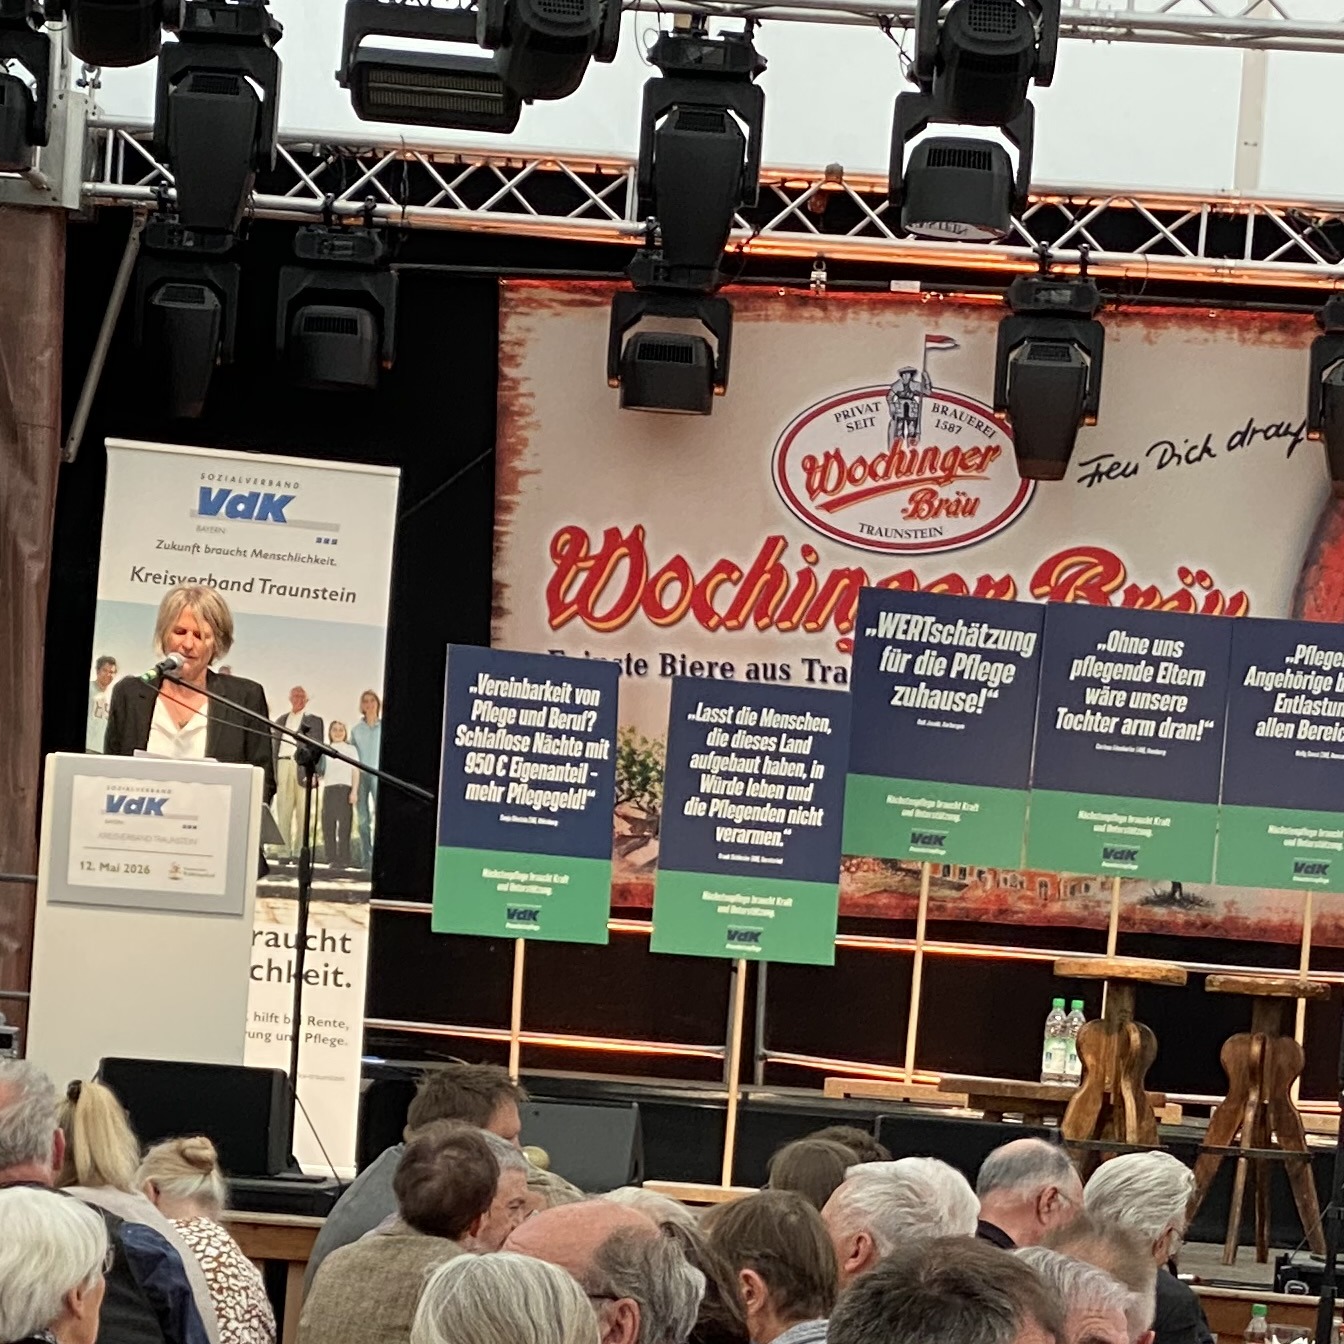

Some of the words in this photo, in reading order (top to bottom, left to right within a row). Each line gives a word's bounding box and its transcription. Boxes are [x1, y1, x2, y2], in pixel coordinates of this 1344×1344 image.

[834, 401, 882, 423] PRIVAT
[931, 402, 997, 440] BRAUEREI
[846, 417, 876, 433] SEIT
[934, 418, 962, 435] 1587
[801, 437, 1002, 502] Wochinger
[1077, 454, 1138, 488] Freu
[1146, 433, 1216, 470] Dich
[200, 472, 300, 489] SOZIALVERBAND
[198, 486, 296, 524] VdK
[901, 488, 981, 521] Bräu
[196, 525, 226, 534] BAYERN
[858, 522, 944, 540] TRAUNSTEIN
[156, 540, 200, 554] Zukunft
[204, 543, 248, 558] braucht
[250, 548, 337, 566] Menschlichkeit.
[259, 578, 356, 604] Traunstein
[865, 612, 1037, 658] „WERTschätzung
[1097, 630, 1149, 655] „Ohne
[1152, 639, 1184, 658] uns
[658, 653, 735, 679] Biere
[745, 662, 791, 680] aus
[879, 646, 912, 673] für
[914, 650, 947, 677] die
[950, 652, 1016, 687] Pflege
[1069, 655, 1154, 683] pflegende
[1157, 662, 1205, 687] Eltern
[1244, 666, 1333, 694] Angehörige
[469, 673, 572, 704] „Vereinbarkeit
[574, 688, 600, 706] von
[890, 682, 999, 714] zuhause!“
[1085, 686, 1126, 707] wäre
[1129, 691, 1188, 713] unsere
[471, 700, 517, 727] Pflege
[519, 706, 547, 727] und
[548, 707, 597, 732] Beruf?
[688, 702, 733, 722] „Lasst
[735, 706, 757, 726] die
[759, 708, 832, 735] Menschen,
[1056, 707, 1120, 733] Tochter
[1121, 718, 1156, 737] arm
[1158, 717, 1214, 741] dran!“
[1255, 717, 1295, 739] allen
[455, 724, 530, 752] Schlaflose
[532, 731, 583, 756] Nächte
[585, 738, 610, 760] mit
[707, 728, 729, 747] die
[731, 730, 776, 751] dieses
[779, 733, 813, 755] Land
[464, 752, 494, 775] 950
[496, 755, 508, 776] €
[509, 757, 588, 784] Eigenanteil
[690, 752, 761, 773] aufgebaut
[763, 755, 807, 780] haben,
[810, 760, 825, 779] in
[465, 781, 505, 803] mehr
[506, 783, 596, 811] Pflegegeld!“
[700, 774, 743, 796] Würde
[746, 779, 785, 800] leben
[787, 783, 814, 802] und
[106, 794, 169, 816] VdK
[684, 797, 707, 816] die
[709, 799, 785, 823] Pflegenden
[787, 807, 824, 826] nicht
[715, 826, 792, 847] verarmen.“
[80, 861, 96, 871] 12.
[100, 862, 120, 872] Mai
[124, 864, 150, 874] 2026
[307, 1016, 349, 1031] Rente,
